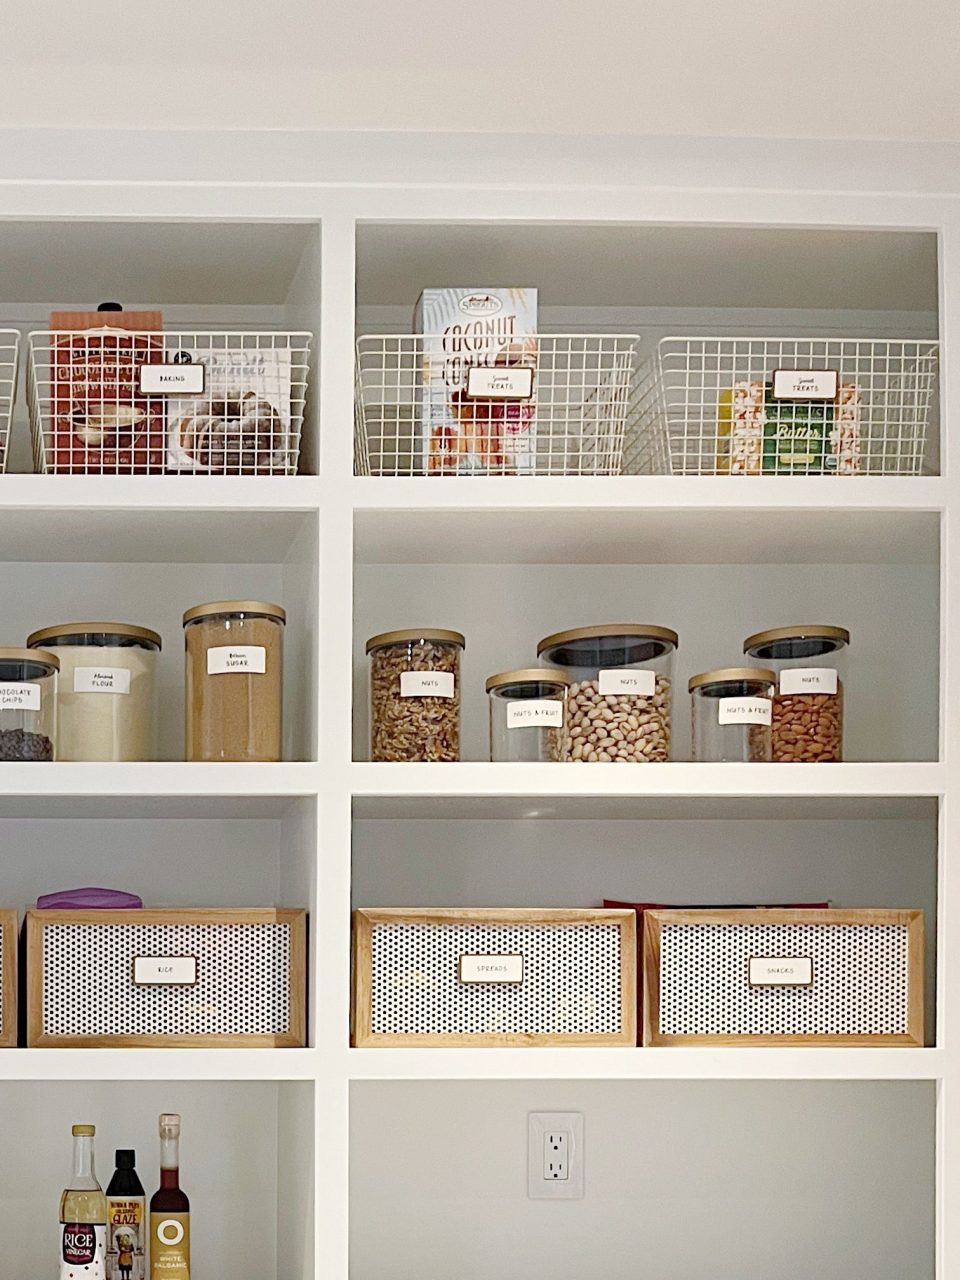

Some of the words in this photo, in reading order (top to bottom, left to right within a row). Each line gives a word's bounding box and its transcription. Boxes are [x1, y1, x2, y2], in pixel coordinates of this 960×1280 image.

[442, 315, 516, 352] COCONUT
[91, 680, 114, 688] FLOUR
[1, 696, 23, 704] CHIPS
[113, 1213, 137, 1225] GLAZE
[64, 1233, 93, 1248] RICE
[65, 1248, 93, 1258] VINEGAR
